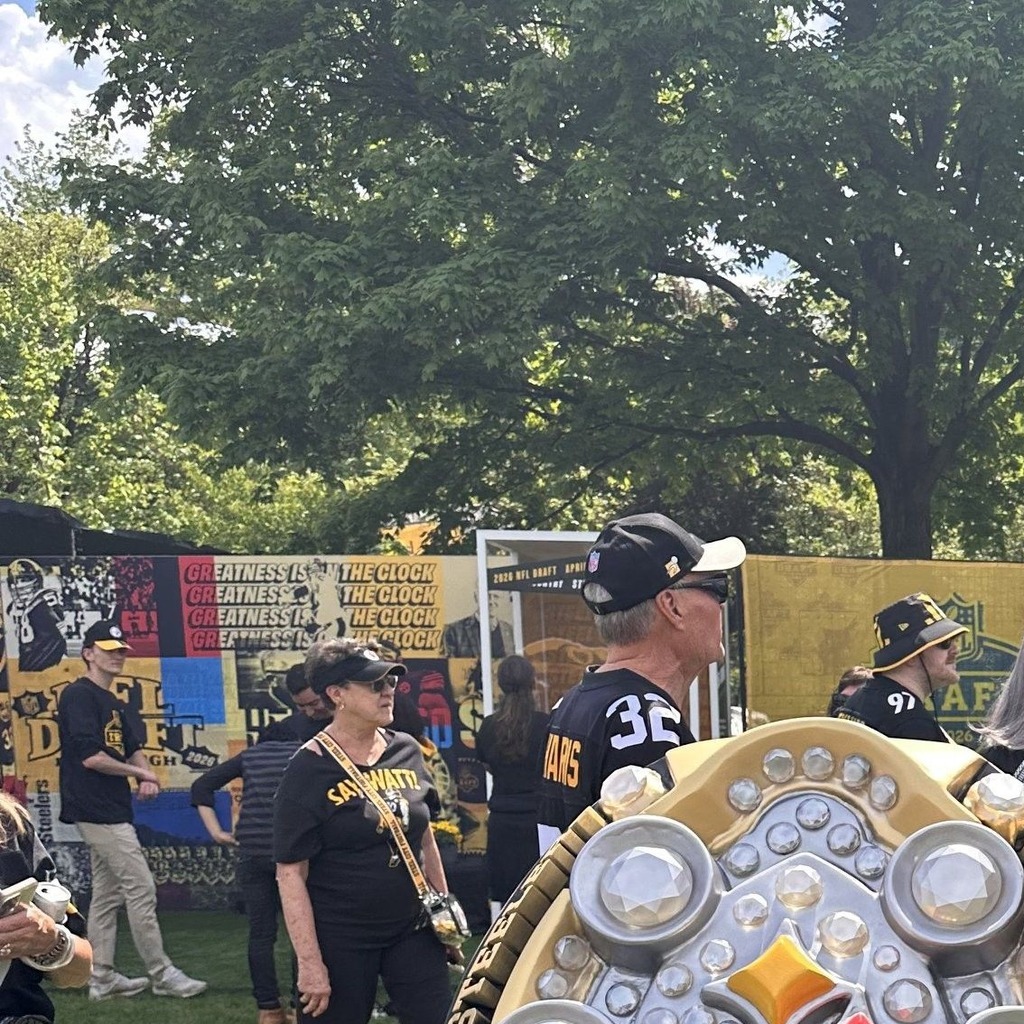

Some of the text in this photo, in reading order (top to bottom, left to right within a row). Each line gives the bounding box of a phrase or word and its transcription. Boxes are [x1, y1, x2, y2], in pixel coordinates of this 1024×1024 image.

[184, 563, 288, 583] GREATNESS
[338, 563, 375, 583] THE
[375, 563, 436, 583] CLOCK
[515, 570, 530, 580] NFL
[532, 566, 557, 578] DRAFT
[341, 585, 377, 605] THE
[378, 585, 438, 605] CLOCK
[189, 607, 291, 628] GREATNESS
[350, 607, 379, 628] HE
[377, 607, 439, 628] CLOCK
[192, 630, 292, 651] GREATNESS
[887, 692, 917, 715] 97
[606, 692, 681, 750] 32
[367, 768, 421, 792] WATT!
